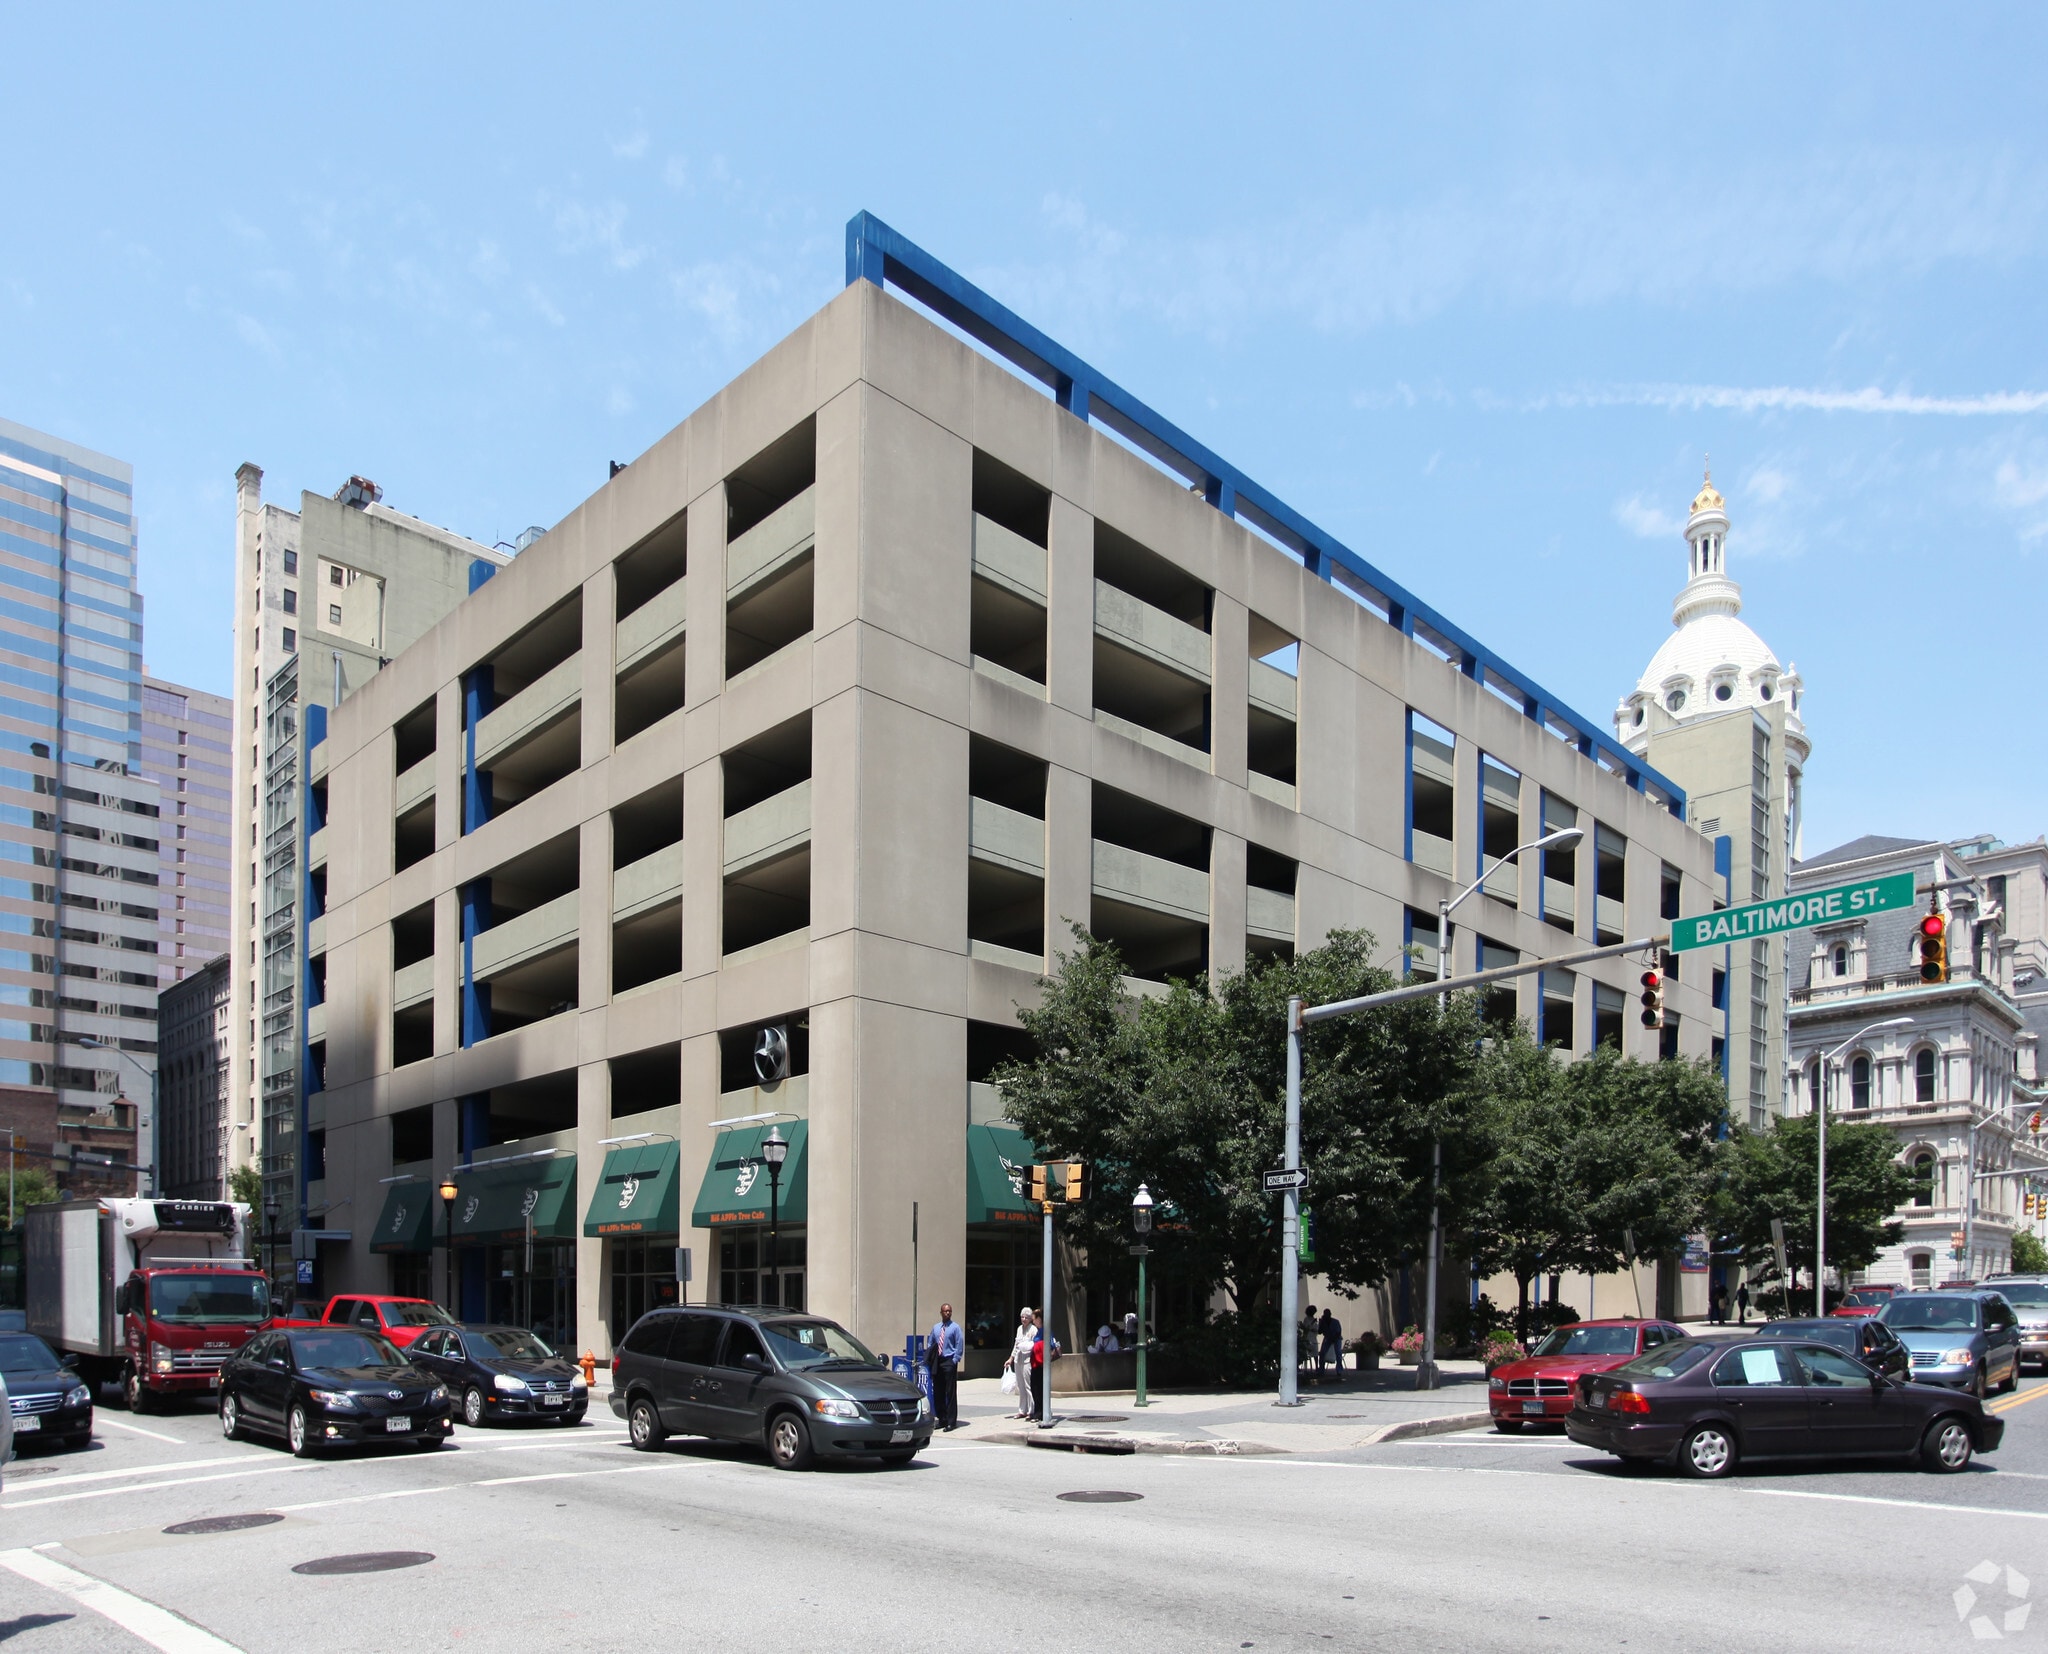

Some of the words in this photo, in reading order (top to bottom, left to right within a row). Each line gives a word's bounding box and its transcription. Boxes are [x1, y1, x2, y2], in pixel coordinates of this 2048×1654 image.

[1696, 892, 1843, 943] BALTIMORE
[1850, 887, 1886, 910] ST.
[1282, 1175, 1295, 1183] WAY
[738, 1212, 751, 1220] Tree
[751, 1211, 765, 1219] Cafe
